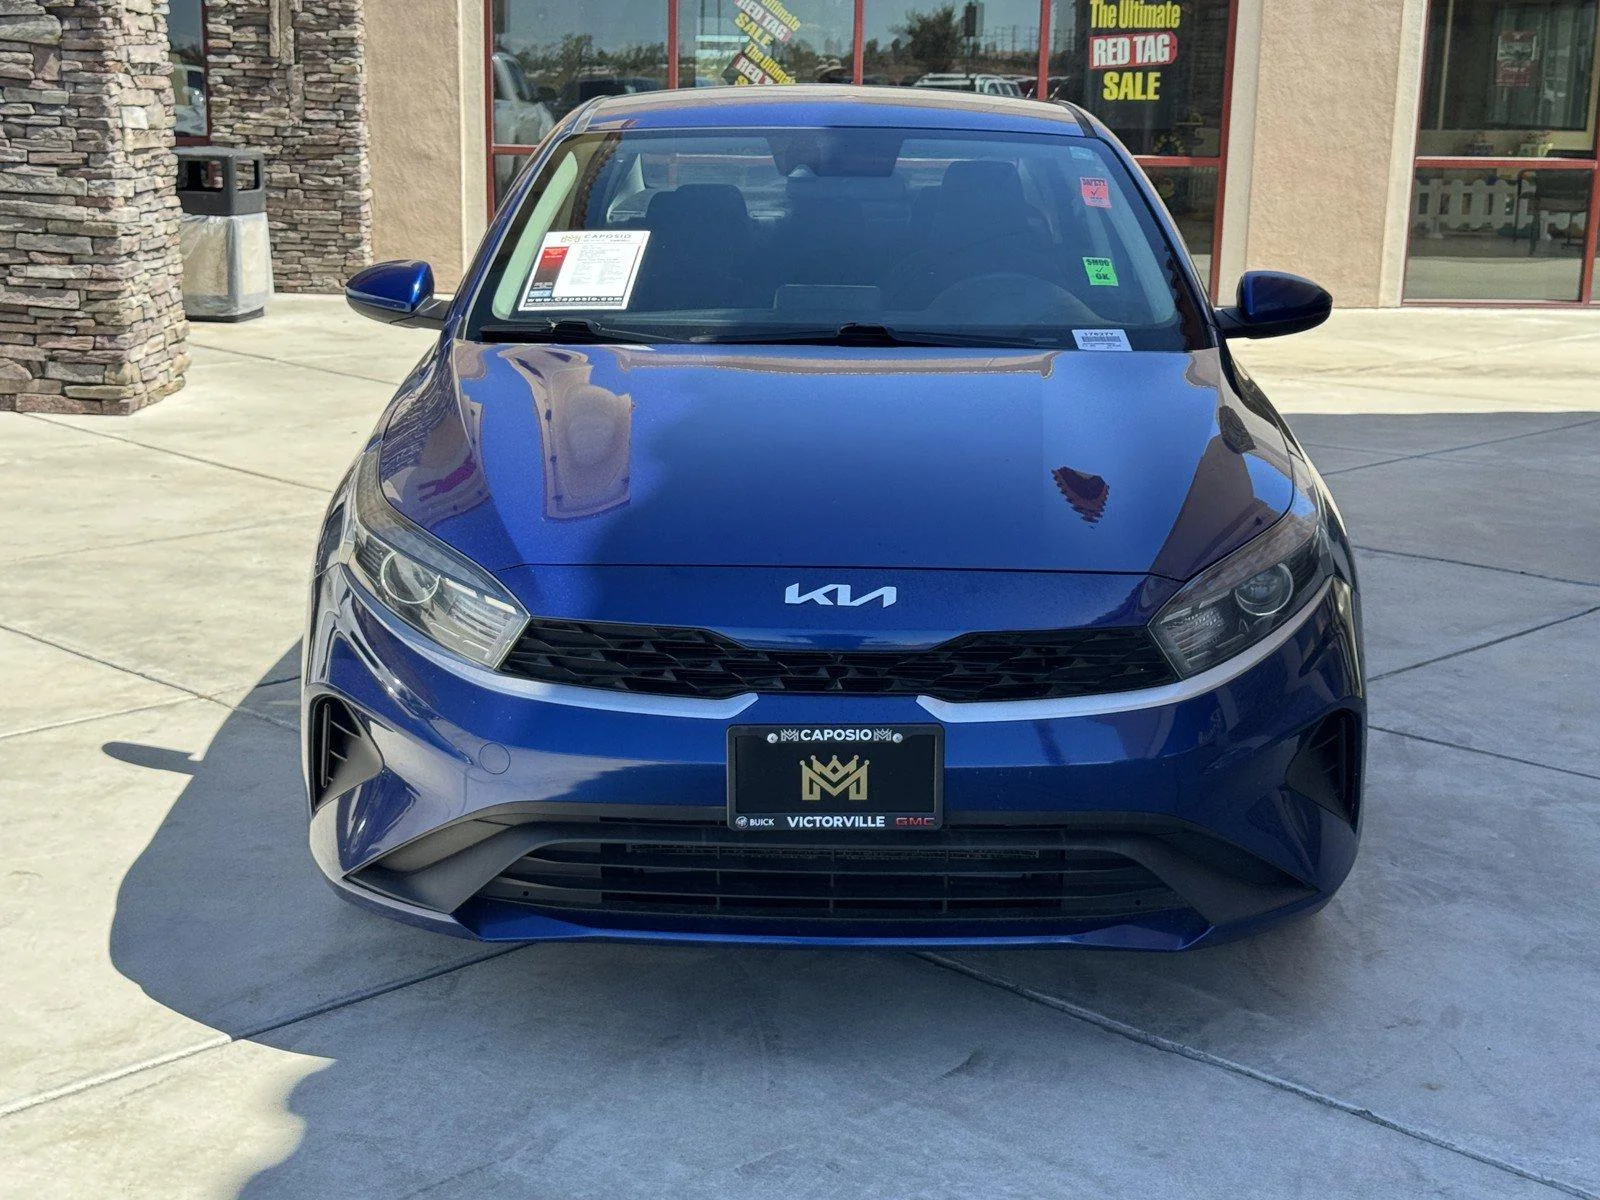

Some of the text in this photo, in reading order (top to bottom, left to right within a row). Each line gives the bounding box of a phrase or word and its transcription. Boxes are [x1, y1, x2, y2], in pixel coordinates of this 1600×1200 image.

[761, 12, 789, 41] TAG
[1089, 0, 1180, 28] The Ultimate
[735, 12, 775, 48] SALE
[745, 43, 764, 63] The
[1093, 34, 1170, 66] RED TAG
[734, 56, 763, 84] RED
[1103, 71, 1161, 100] SALE
[785, 582, 897, 608] KIA
[800, 729, 872, 741] CAPOSIO
[750, 818, 775, 827] BUICK
[787, 816, 885, 828] VICTORVILLE
[895, 817, 935, 826] GMC
